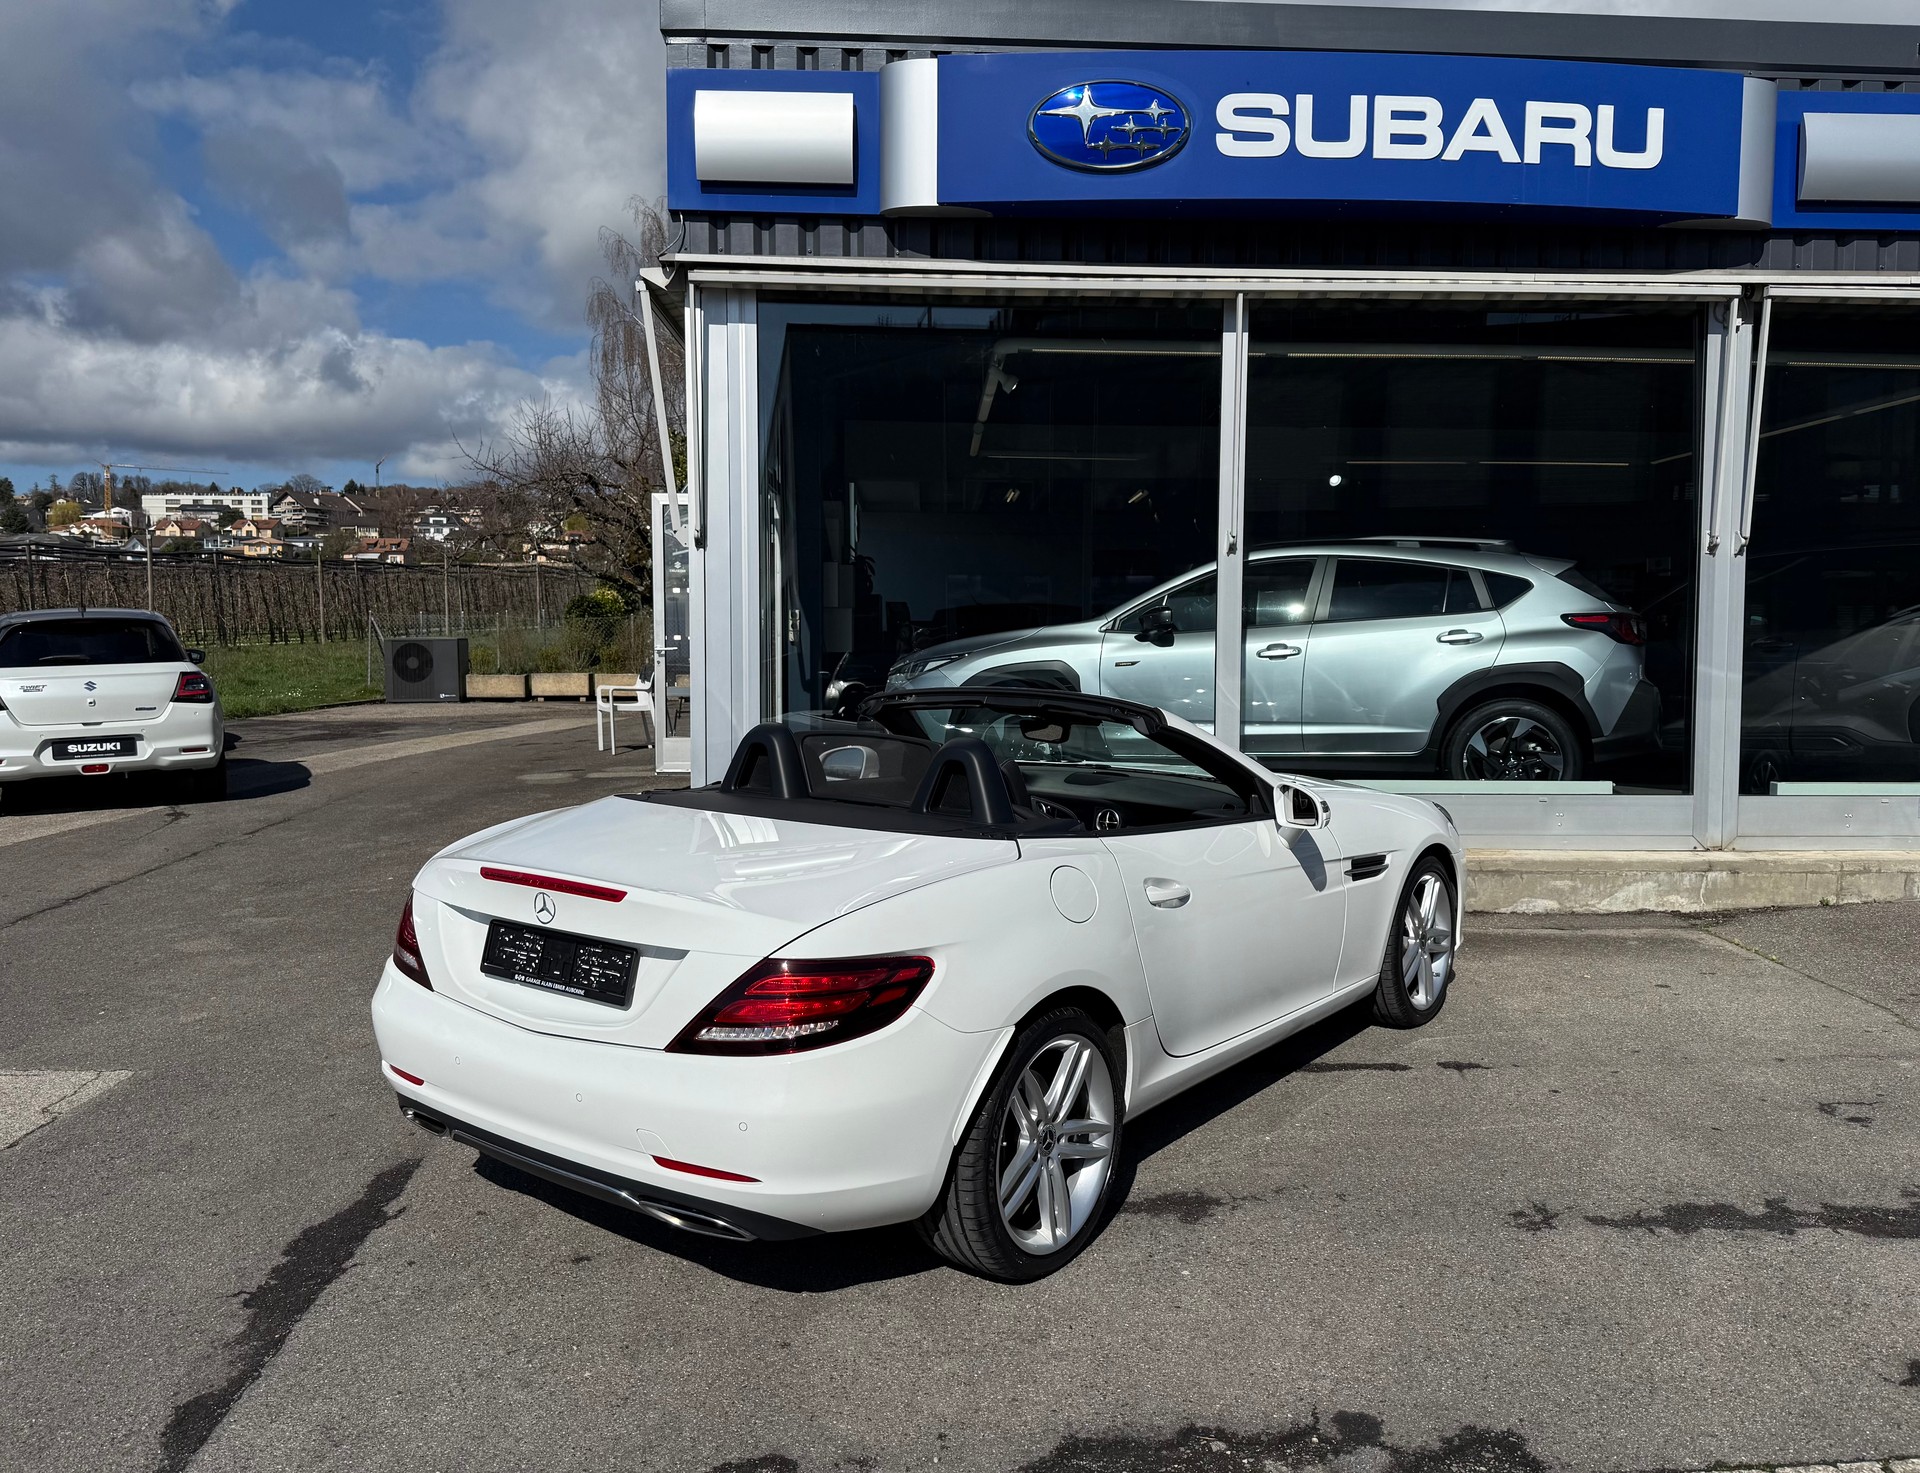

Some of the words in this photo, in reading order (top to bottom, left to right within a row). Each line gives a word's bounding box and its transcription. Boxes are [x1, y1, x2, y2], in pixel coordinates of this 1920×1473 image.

[1215, 92, 1665, 169] SUBARU
[67, 742, 121, 753] SUZUKI
[525, 976, 541, 985] GARAGE
